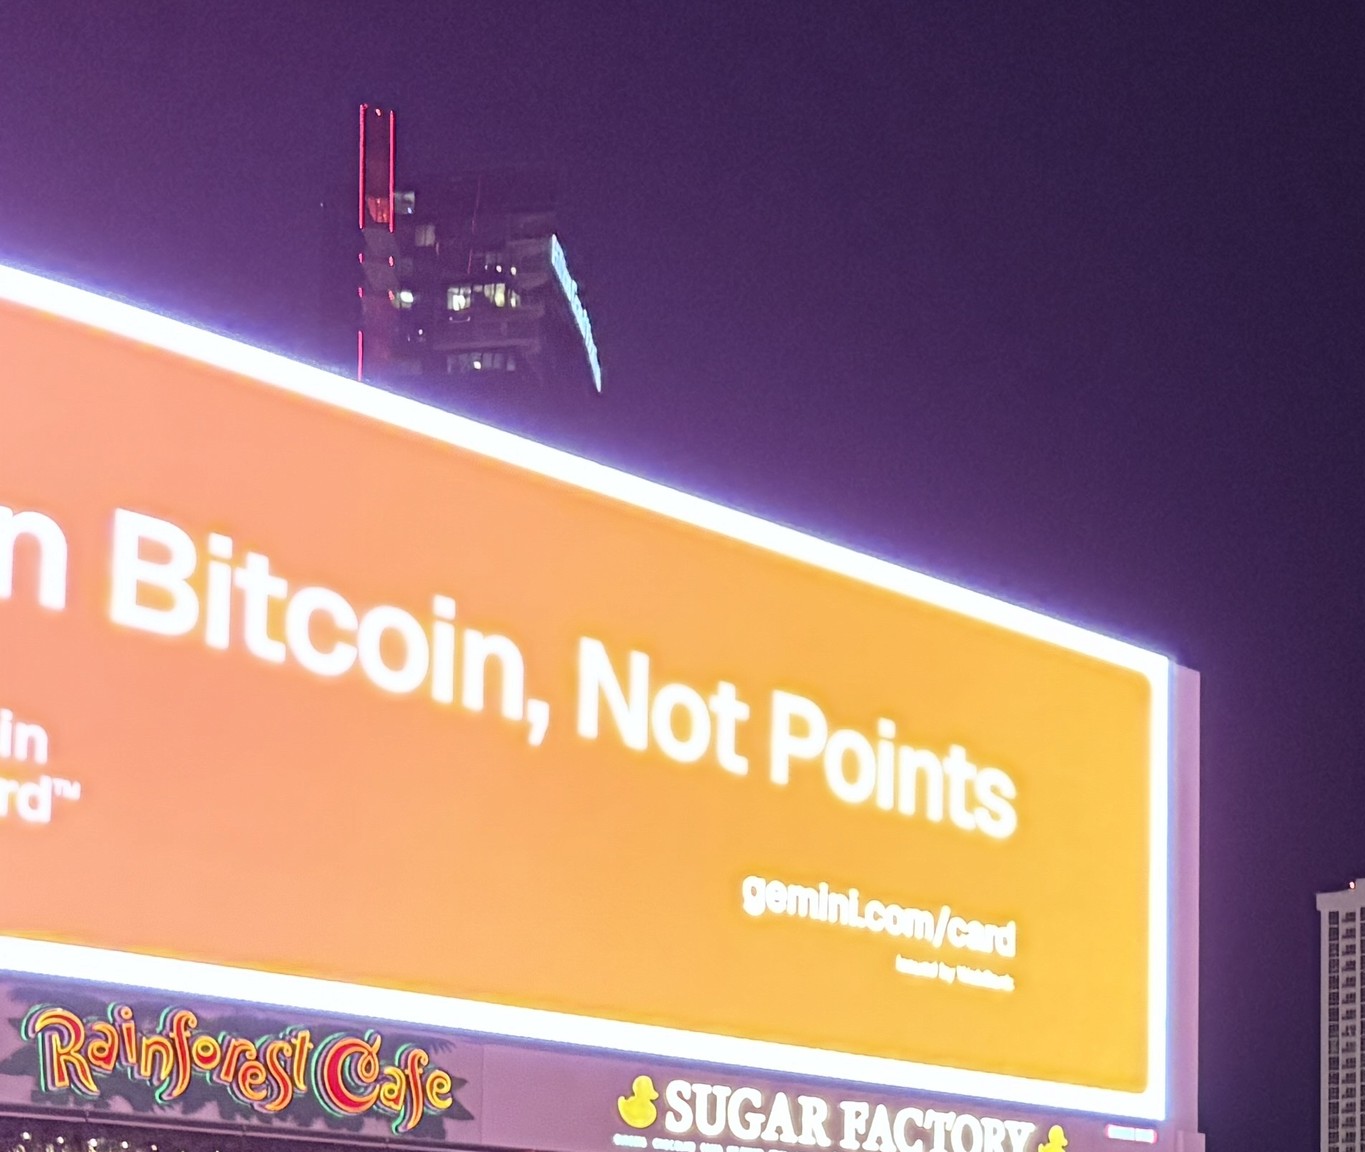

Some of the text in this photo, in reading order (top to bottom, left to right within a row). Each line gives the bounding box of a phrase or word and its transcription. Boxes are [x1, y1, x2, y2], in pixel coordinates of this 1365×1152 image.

[110, 507, 550, 747] Bitcoin,
[577, 635, 751, 776] Not
[770, 689, 1018, 839] Points
[742, 875, 1016, 958] gemini.com/card
[22, 1003, 455, 1134] Rainforest Cafe
[665, 1080, 832, 1147] SUGAR
